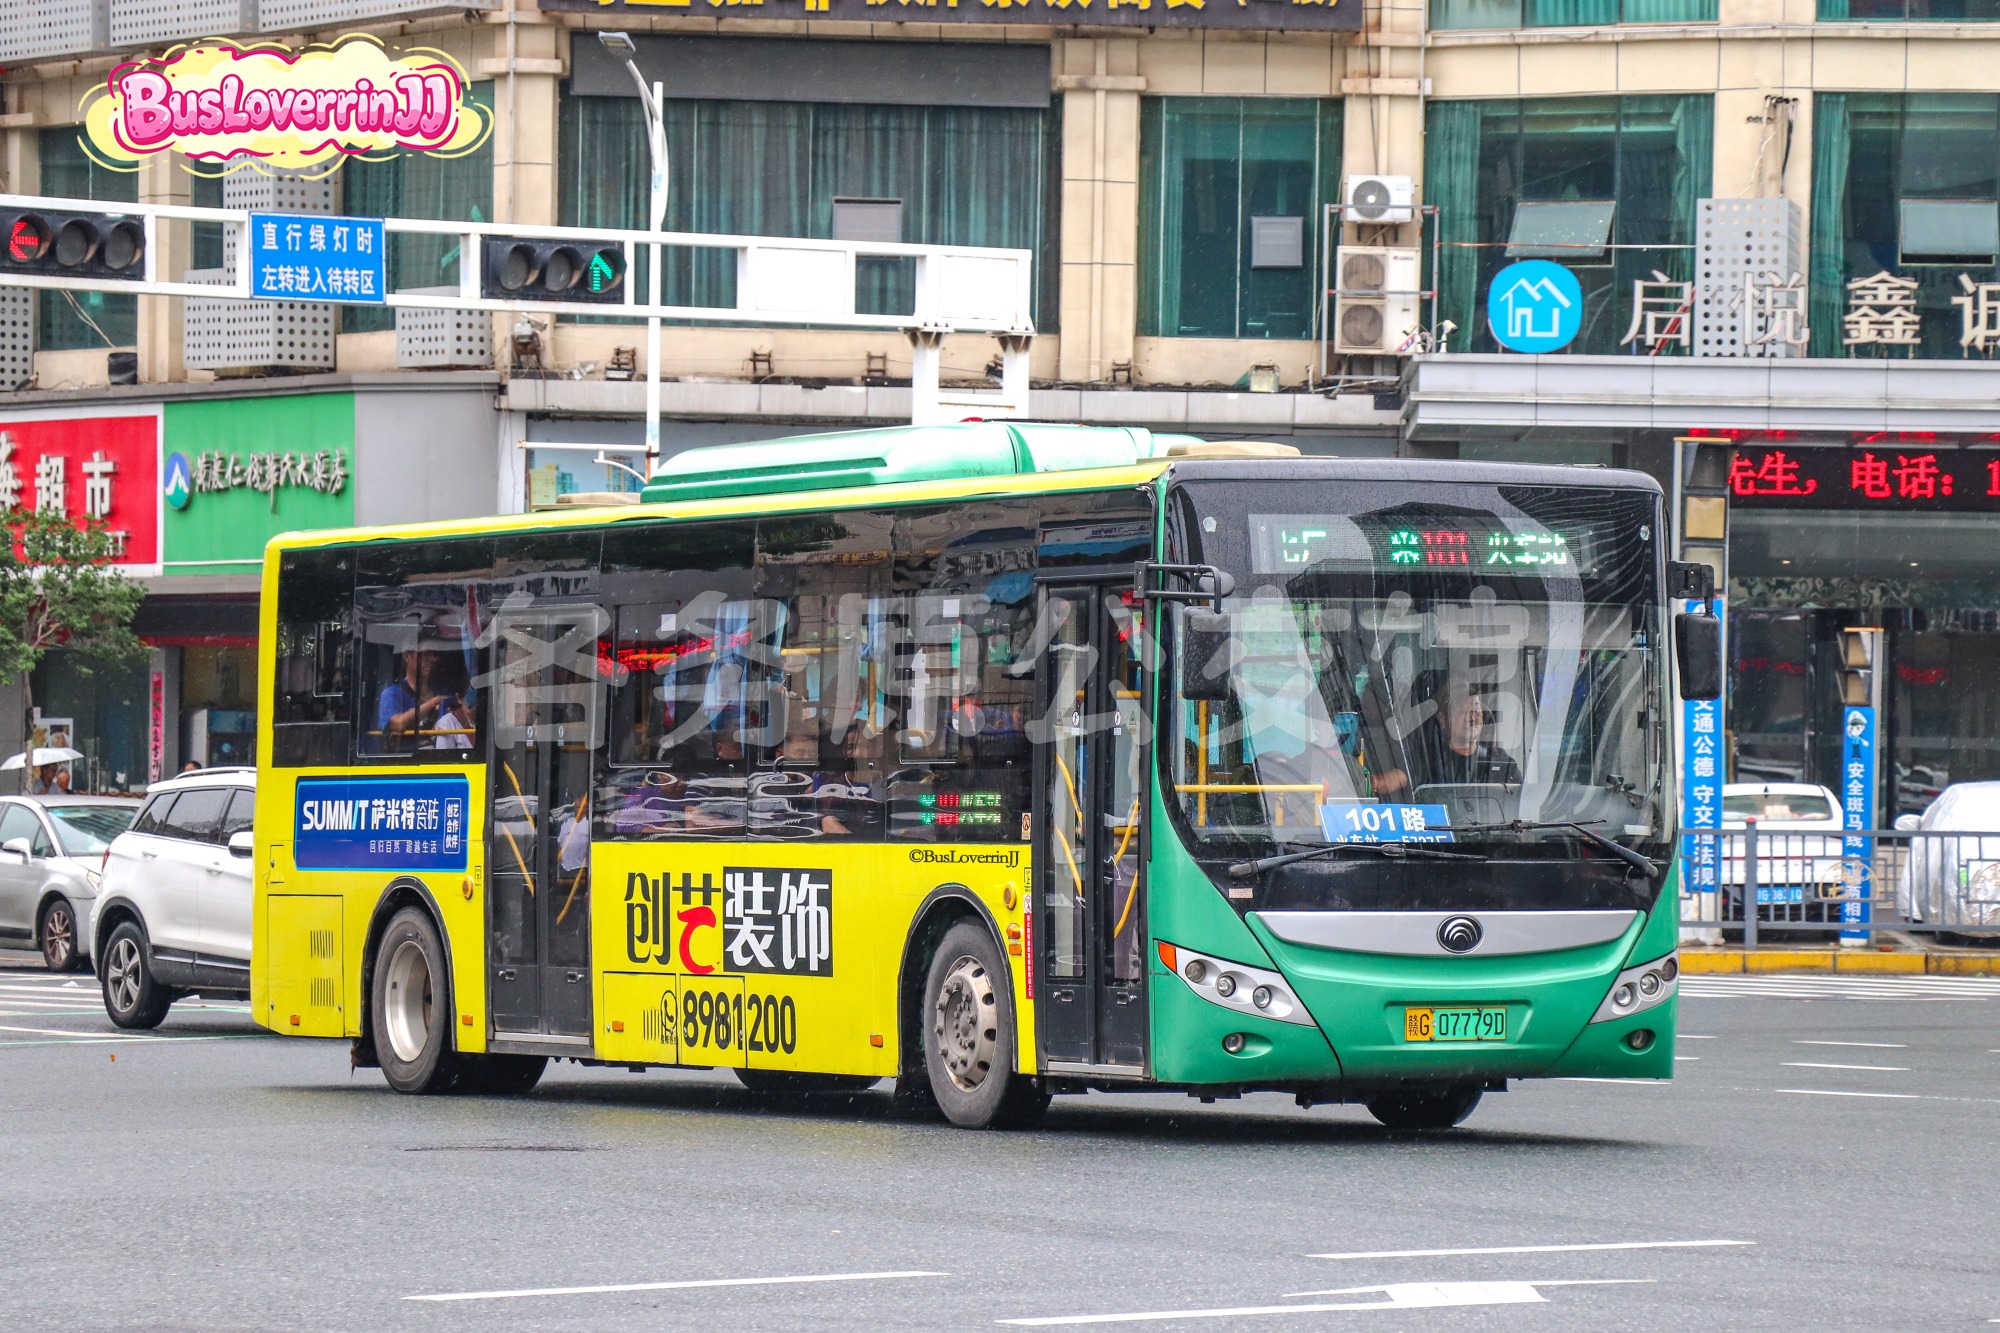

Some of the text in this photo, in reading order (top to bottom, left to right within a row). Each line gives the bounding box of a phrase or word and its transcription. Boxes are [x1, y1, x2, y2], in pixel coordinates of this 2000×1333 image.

[261, 221, 374, 254] 直行绿灯时
[261, 264, 376, 295] 左转进入待转区
[302, 798, 439, 831] SUMMIT 萨米特瓷砖
[683, 989, 797, 1055] 8981200
